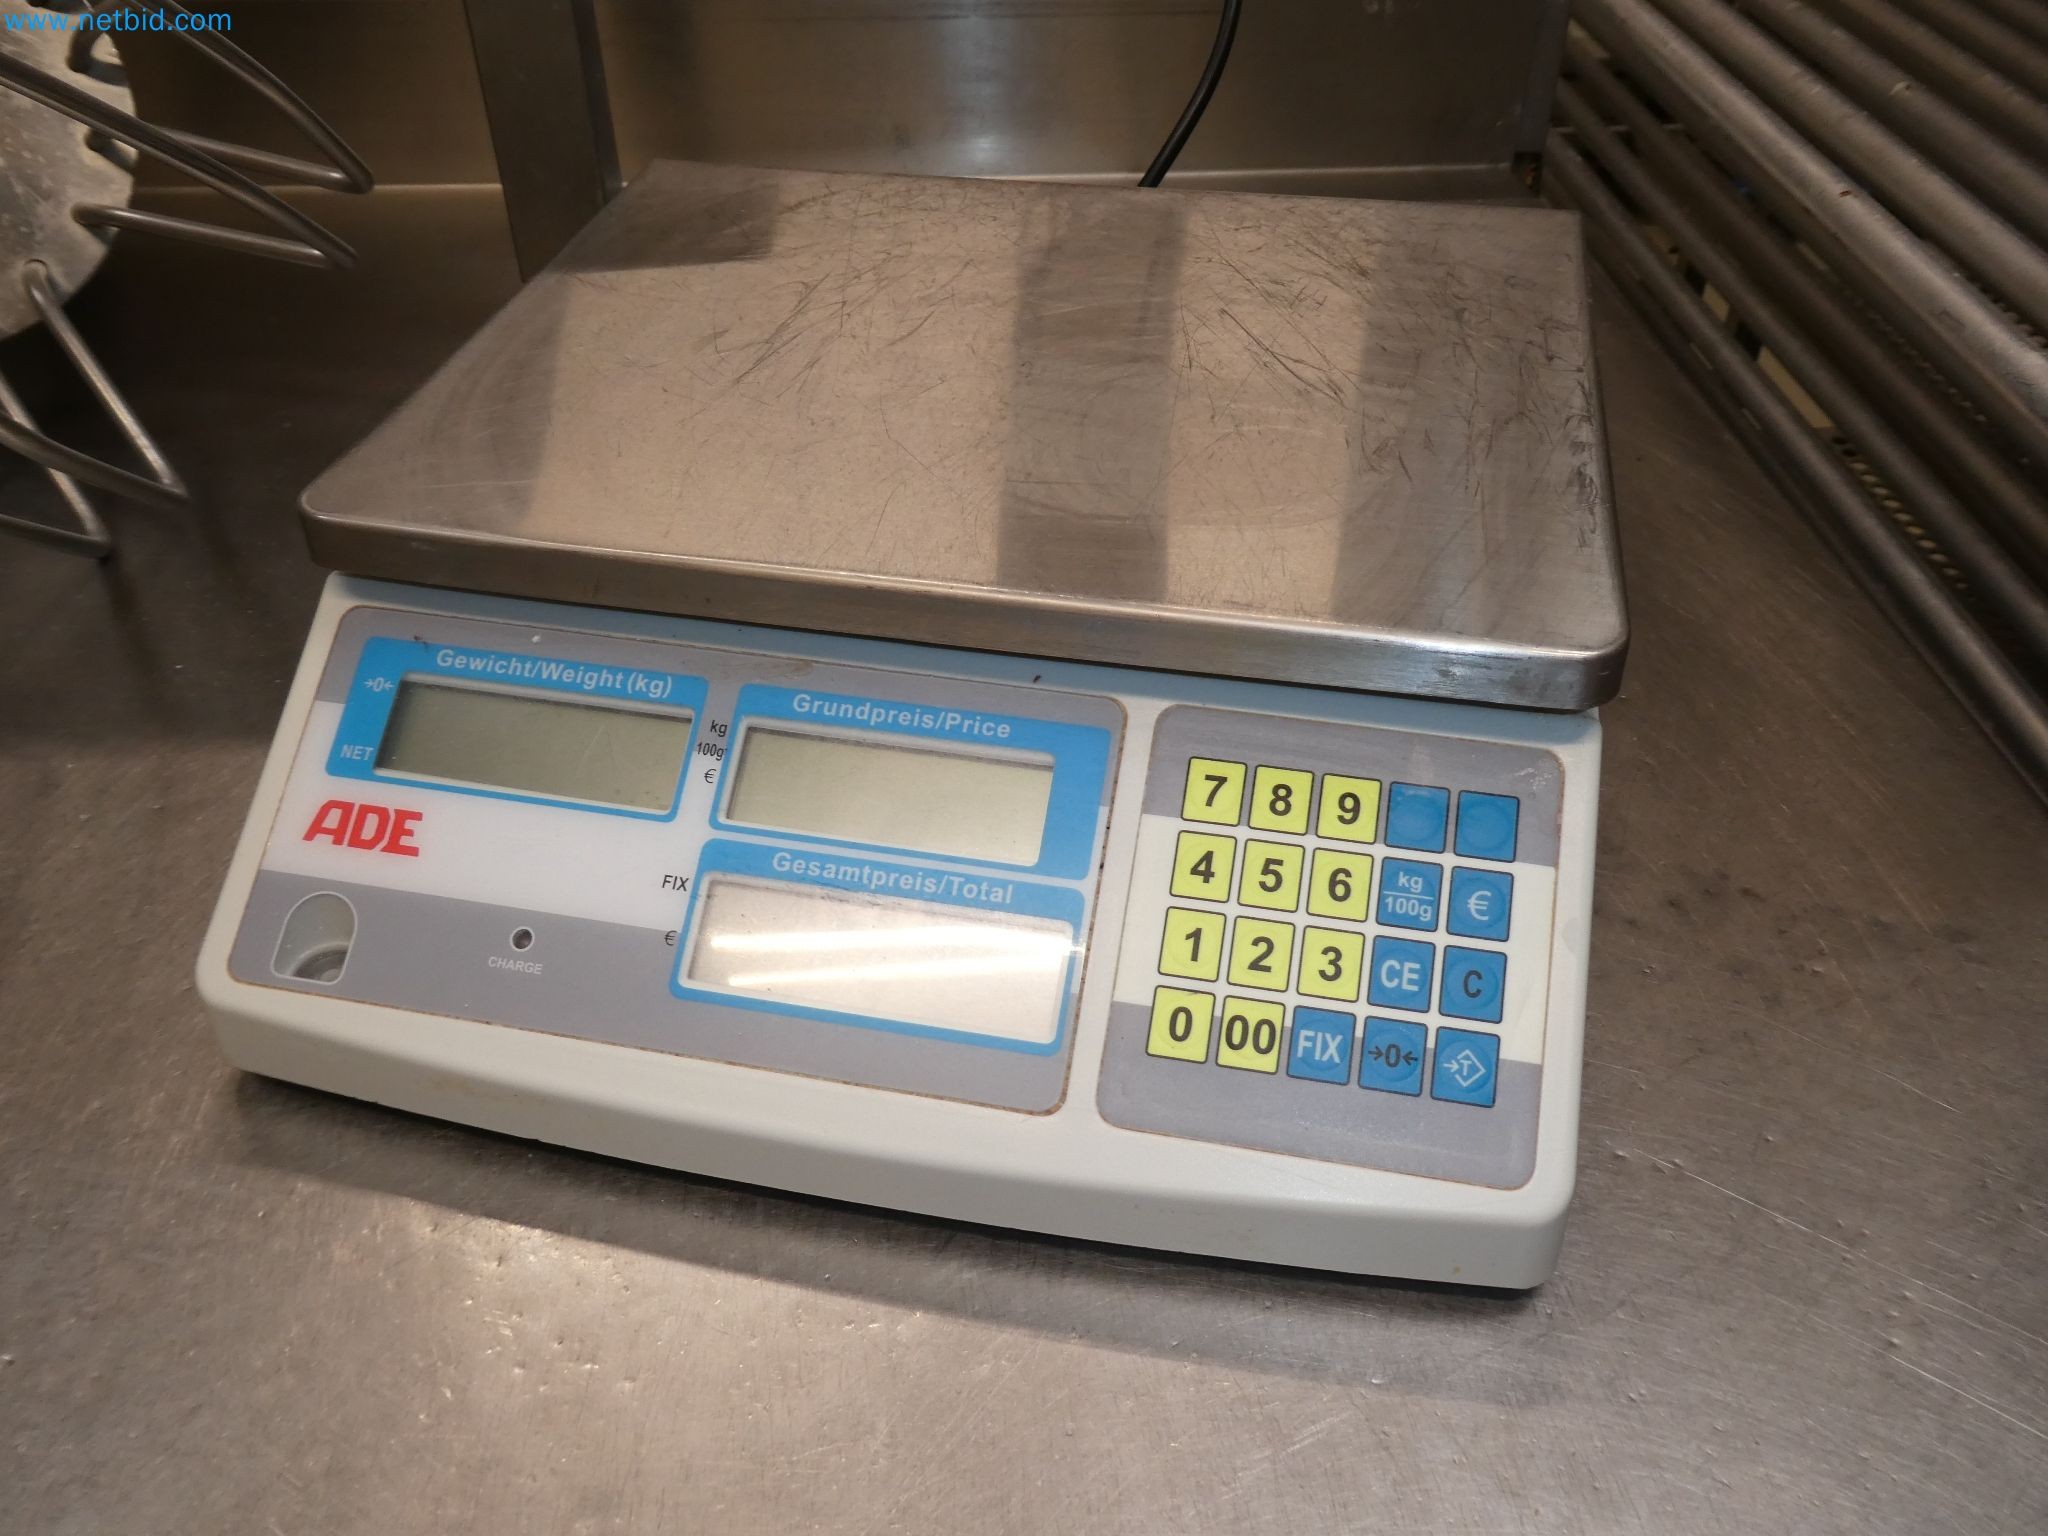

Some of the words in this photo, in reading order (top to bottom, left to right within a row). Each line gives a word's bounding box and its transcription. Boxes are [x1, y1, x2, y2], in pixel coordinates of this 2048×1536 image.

[437, 649, 622, 690] Gewicht/Weight
[628, 672, 672, 698] (kg)
[710, 720, 728, 737] kg
[792, 693, 1011, 739] Grundpreis/Price
[340, 744, 374, 761] NET
[704, 768, 717, 784] €
[1203, 774, 1228, 807] 7
[1269, 783, 1293, 816] 8
[1336, 792, 1361, 825] 9
[303, 800, 423, 857] ADE
[662, 874, 690, 892] FIX
[772, 851, 1013, 905] Gesamtpreis/Total
[1190, 850, 1215, 884] 4
[1258, 858, 1283, 892] 5
[1398, 872, 1423, 894] kg
[1328, 868, 1352, 902] 6
[1384, 897, 1433, 922] 100g
[1467, 890, 1491, 921] €
[664, 930, 677, 946] €
[1184, 927, 1204, 962] 1
[1247, 936, 1274, 973] 2
[488, 955, 544, 975] CHARGE
[1318, 946, 1343, 981] 3
[1380, 959, 1421, 992] CE
[1463, 970, 1484, 999] C
[1168, 1006, 1193, 1043] 0
[1225, 1014, 1277, 1055] 00
[1297, 1030, 1343, 1064] FIX
